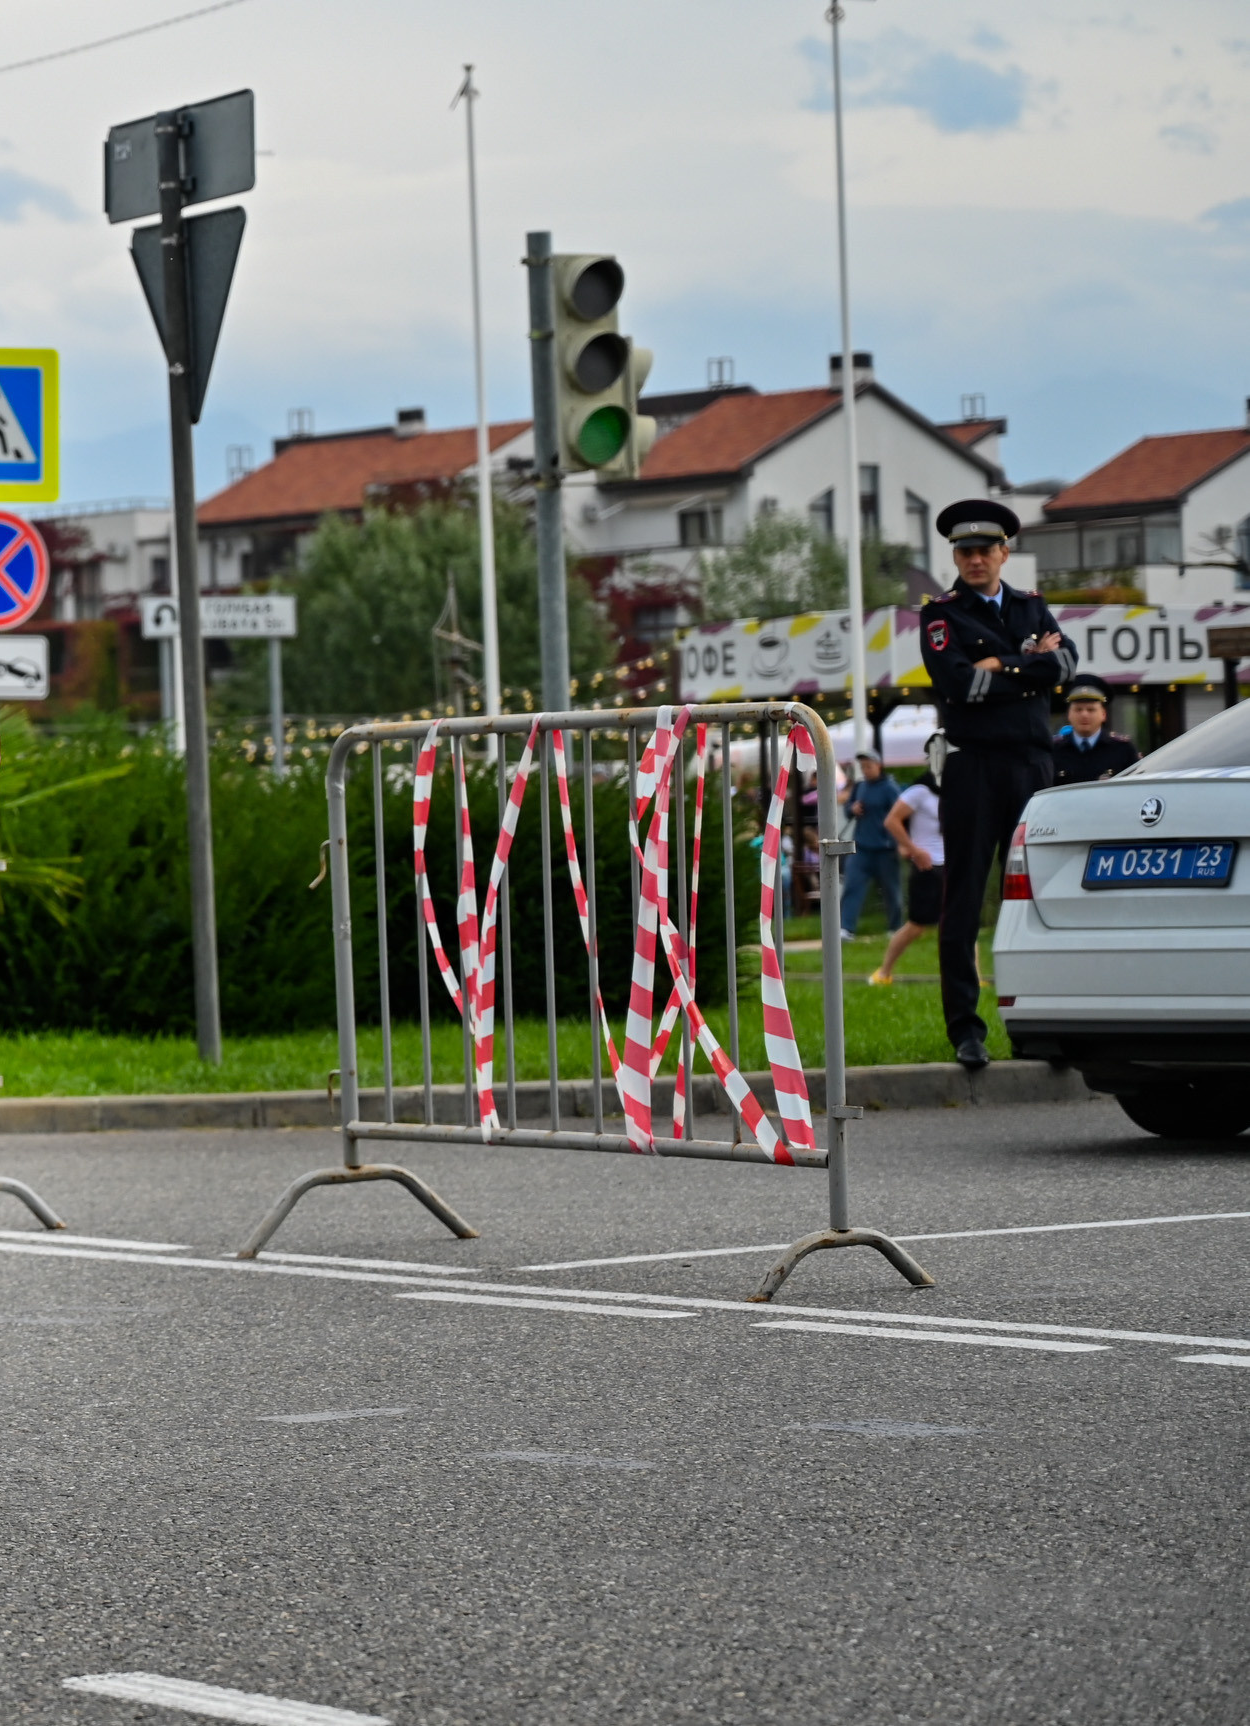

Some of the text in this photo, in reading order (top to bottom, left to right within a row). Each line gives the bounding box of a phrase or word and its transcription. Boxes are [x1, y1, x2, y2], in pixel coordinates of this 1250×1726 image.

[685, 641, 736, 680] ОФЕ
[1121, 848, 1183, 876] 0331
[1196, 845, 1223, 867] 23
[1197, 867, 1216, 876] RUS
